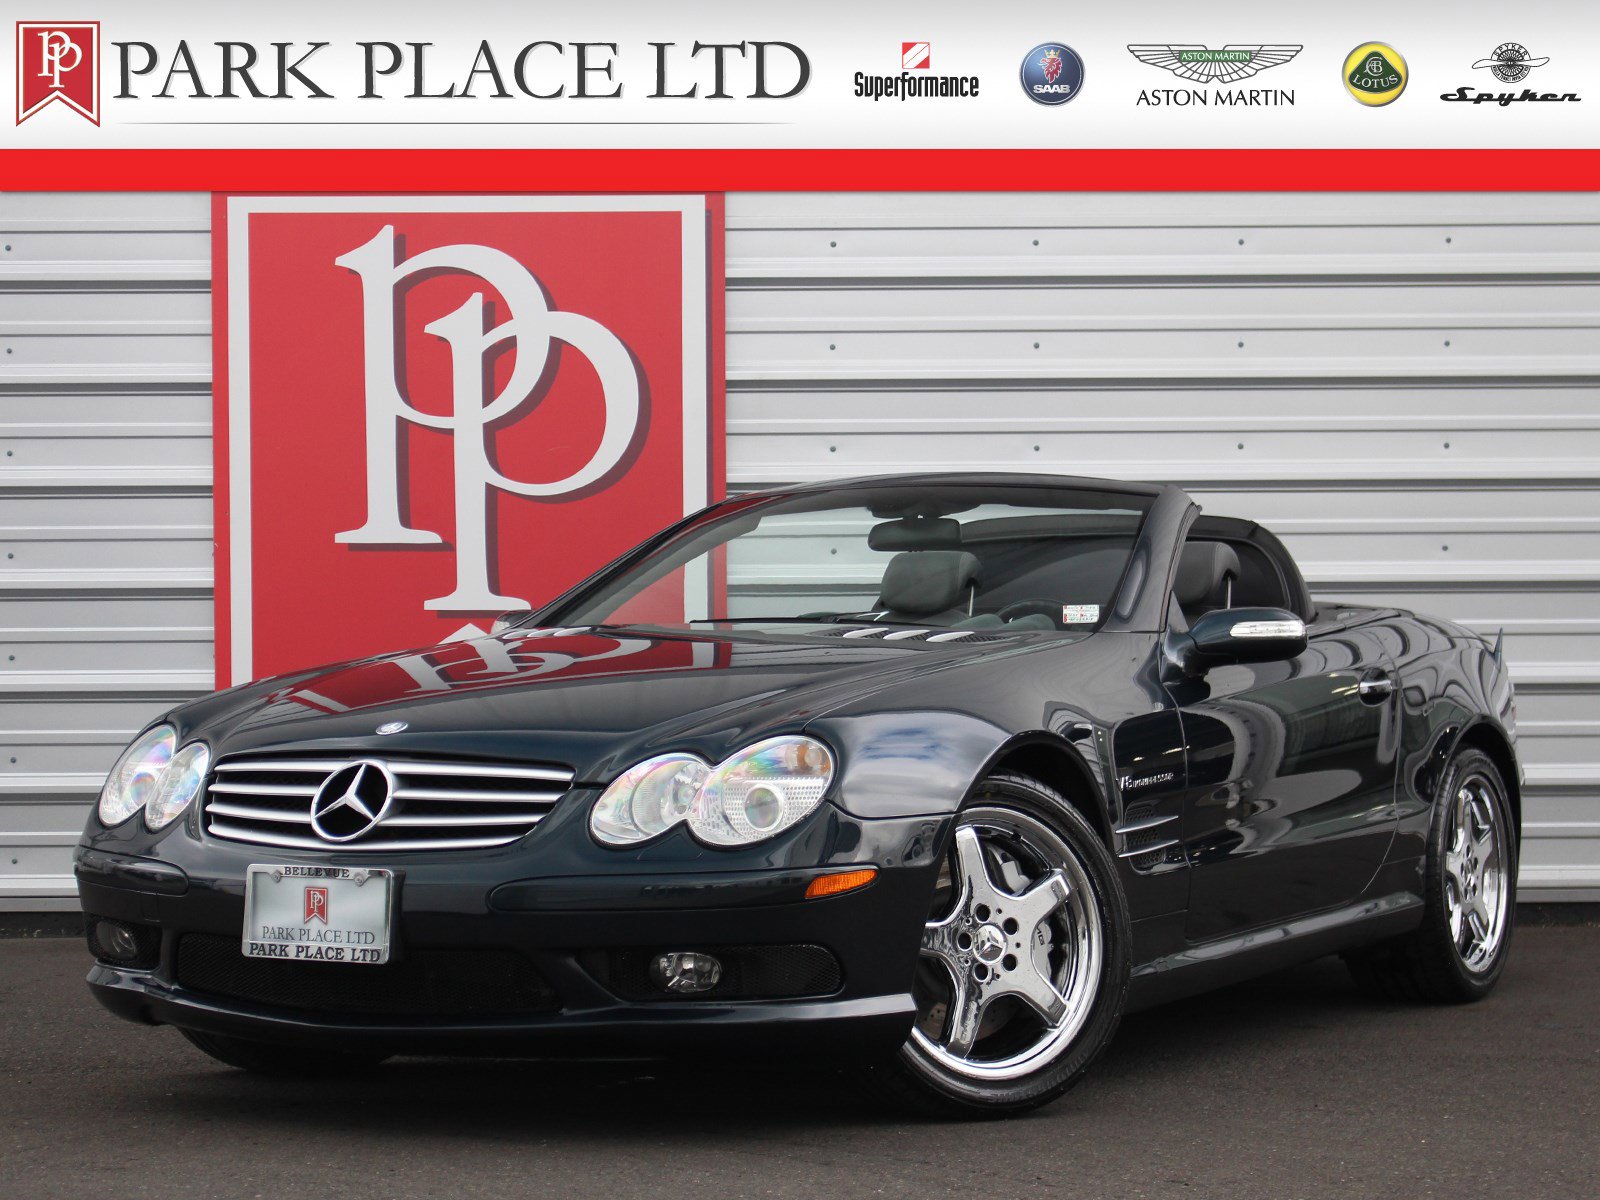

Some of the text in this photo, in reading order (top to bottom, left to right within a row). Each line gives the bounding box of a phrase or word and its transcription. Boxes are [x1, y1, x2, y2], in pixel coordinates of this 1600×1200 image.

[284, 866, 350, 878] BELLEVUE
[262, 926, 375, 945] PARK PLACE LTD
[249, 943, 381, 962] PARK PLACE LTD
